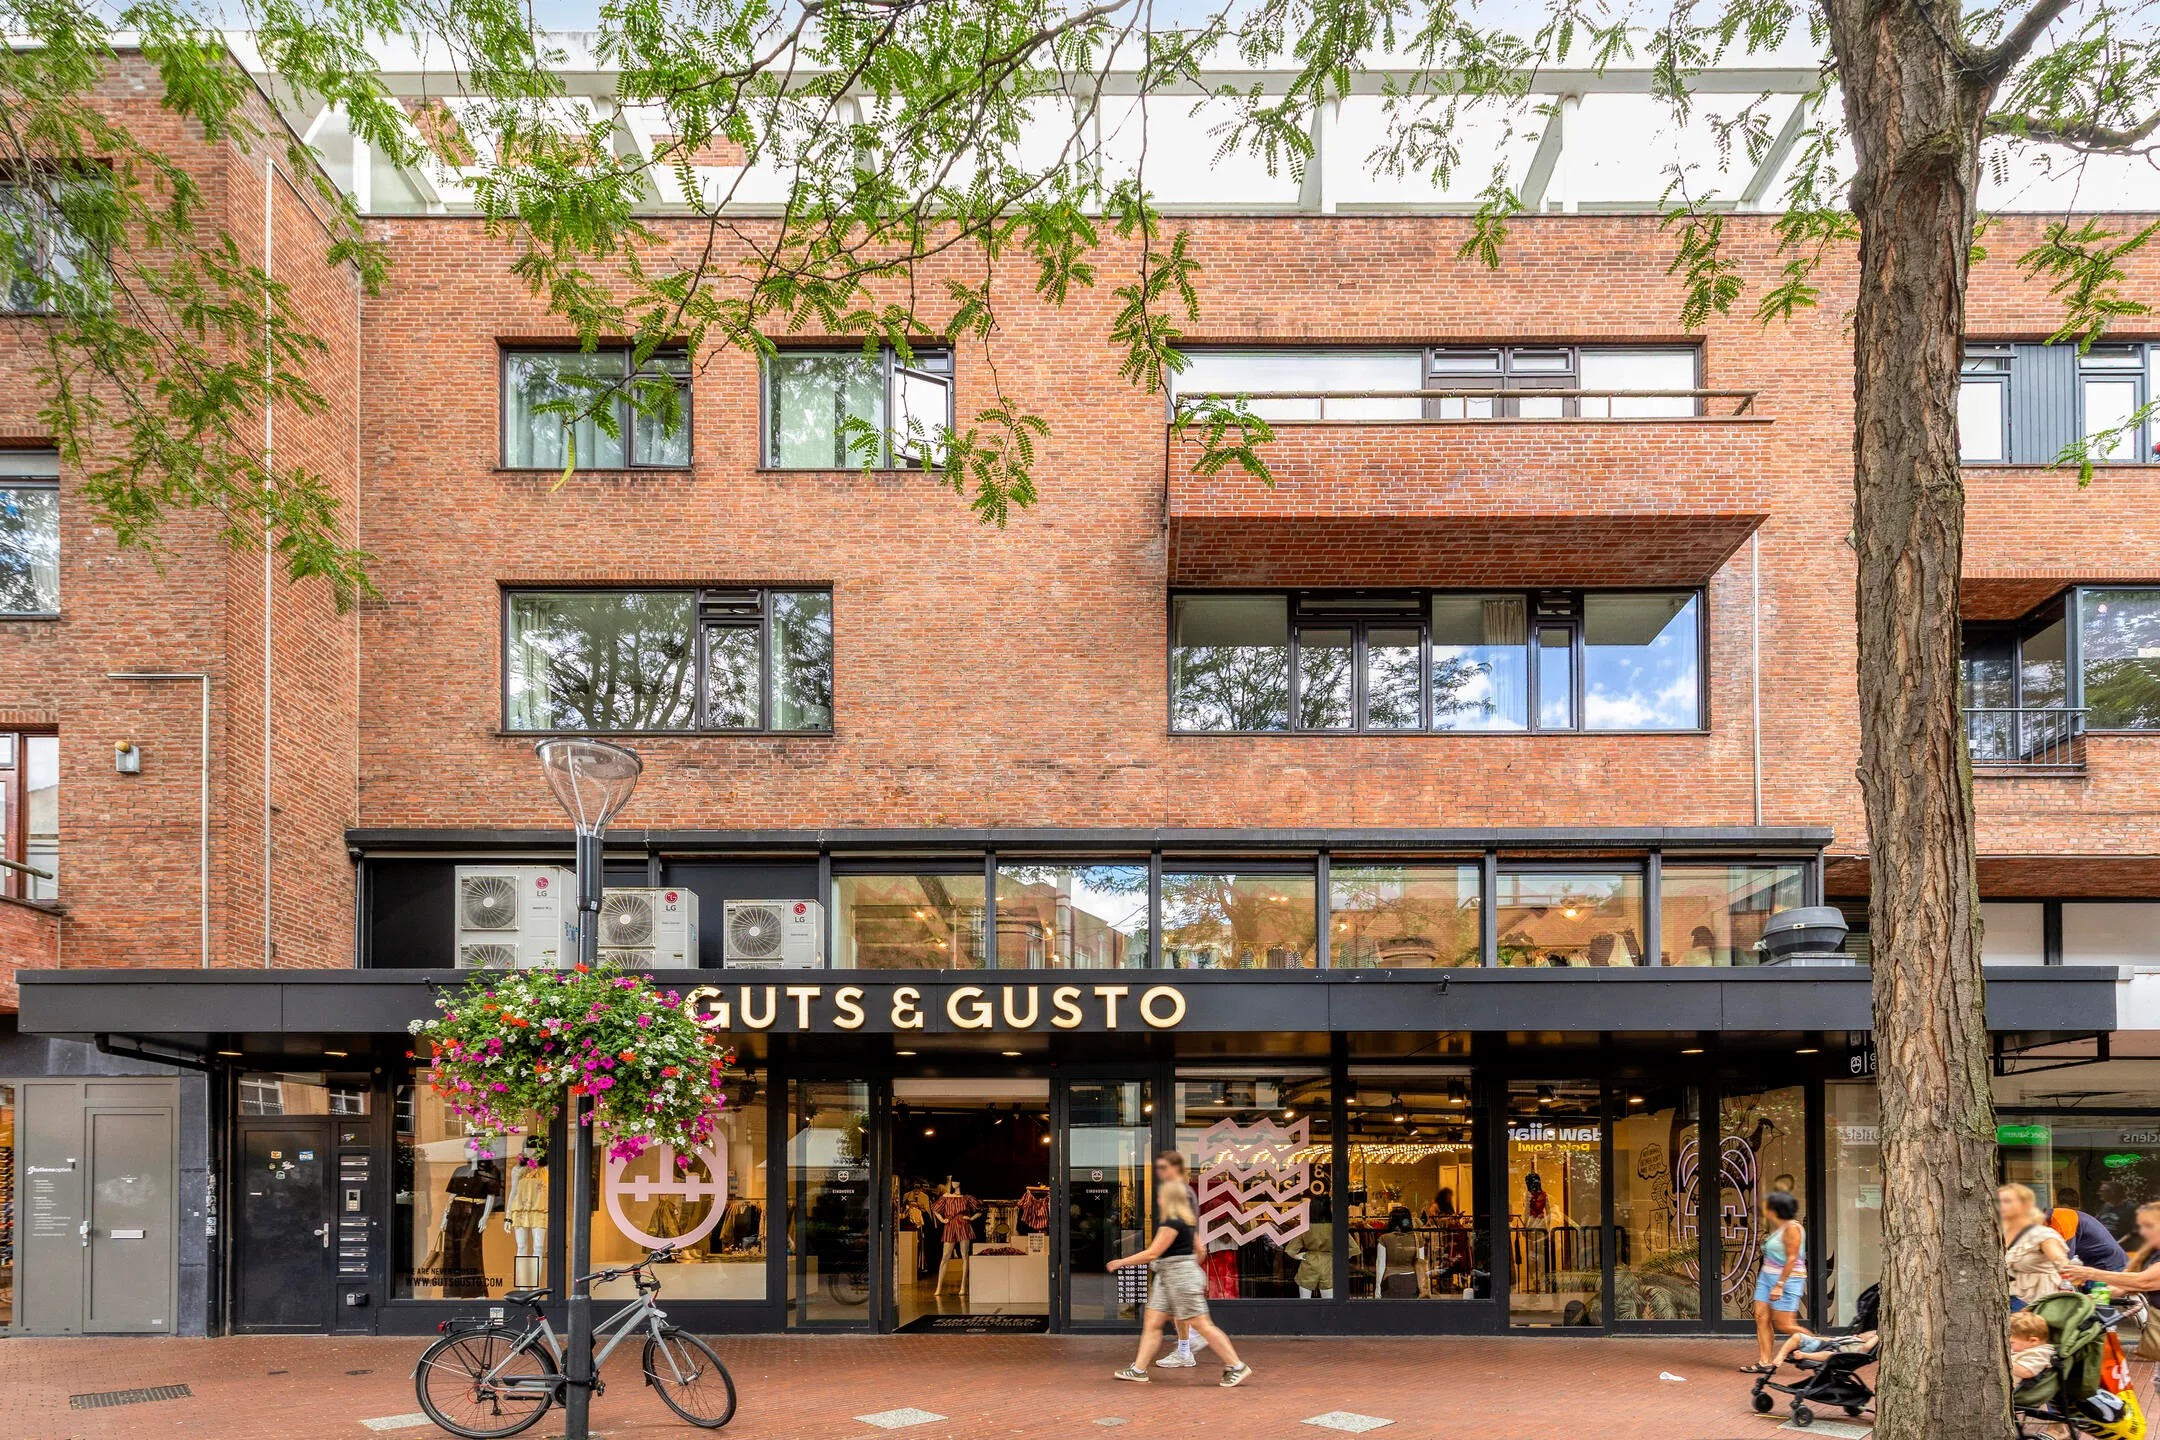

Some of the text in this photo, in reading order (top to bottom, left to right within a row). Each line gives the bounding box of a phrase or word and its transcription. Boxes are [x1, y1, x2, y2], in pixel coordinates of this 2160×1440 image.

[665, 904, 677, 912] LG
[794, 916, 806, 924] LG
[684, 985, 1187, 1030] GUTS & GUSTO
[417, 1267, 429, 1275] ARE
